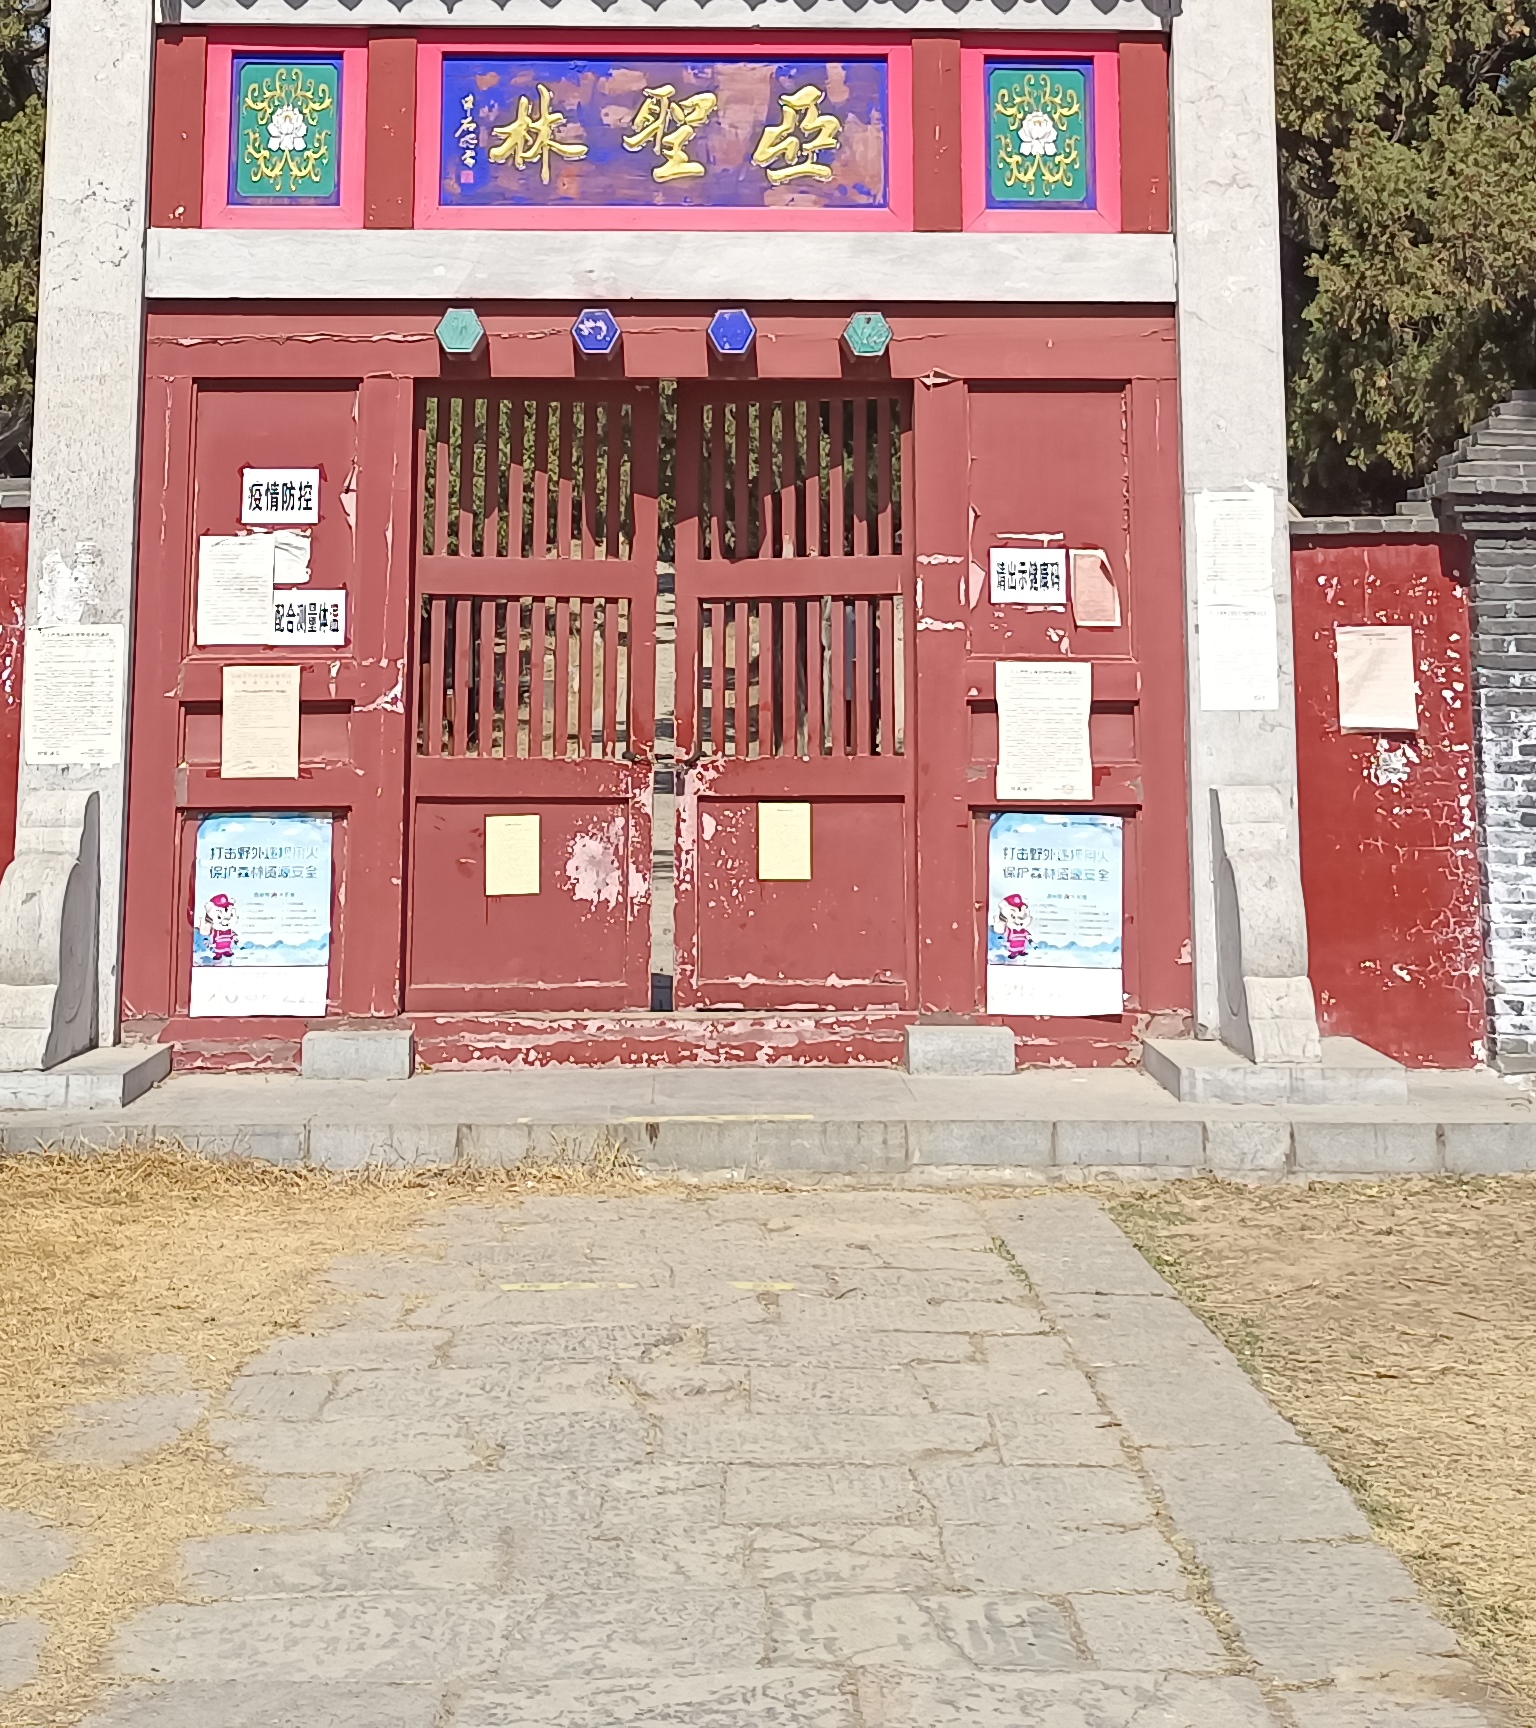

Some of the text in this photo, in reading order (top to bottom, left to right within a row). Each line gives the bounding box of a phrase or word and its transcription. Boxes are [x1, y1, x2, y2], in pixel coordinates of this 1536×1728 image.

[248, 480, 313, 512] 疫情防控
[275, 602, 340, 633] 配合测量体温
